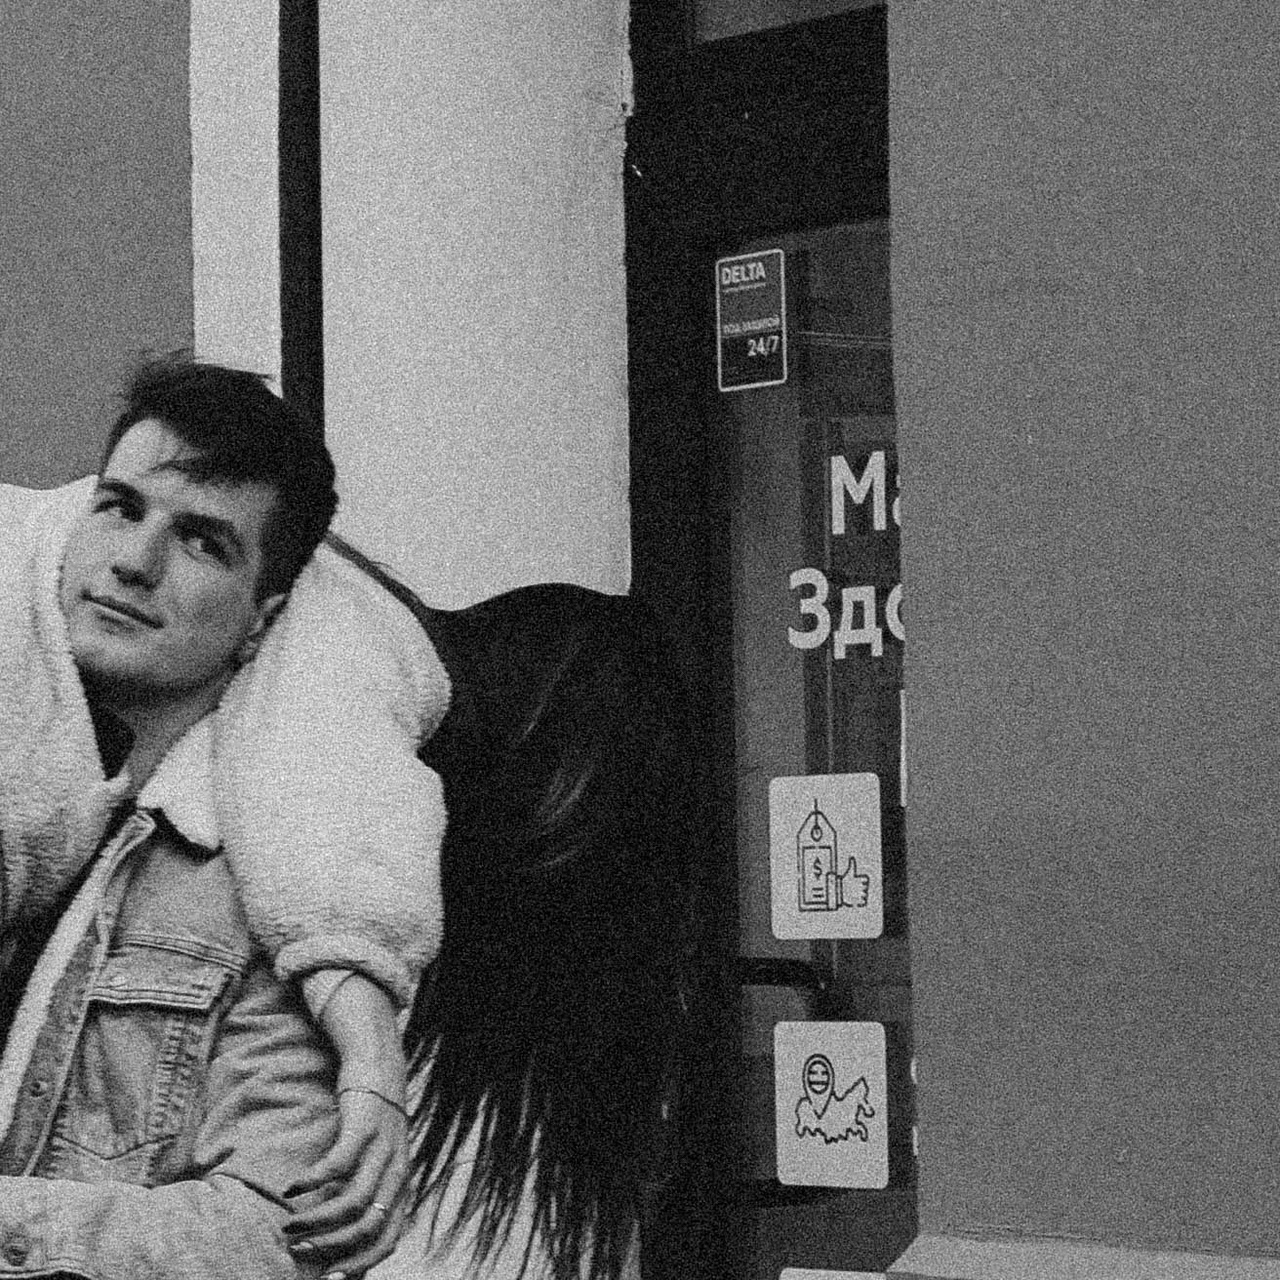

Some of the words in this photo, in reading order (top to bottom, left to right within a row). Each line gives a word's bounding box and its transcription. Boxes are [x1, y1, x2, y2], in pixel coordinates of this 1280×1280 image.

[721, 261, 766, 286] DELTA
[747, 335, 779, 357] 24/7
[830, 451, 901, 535] М
